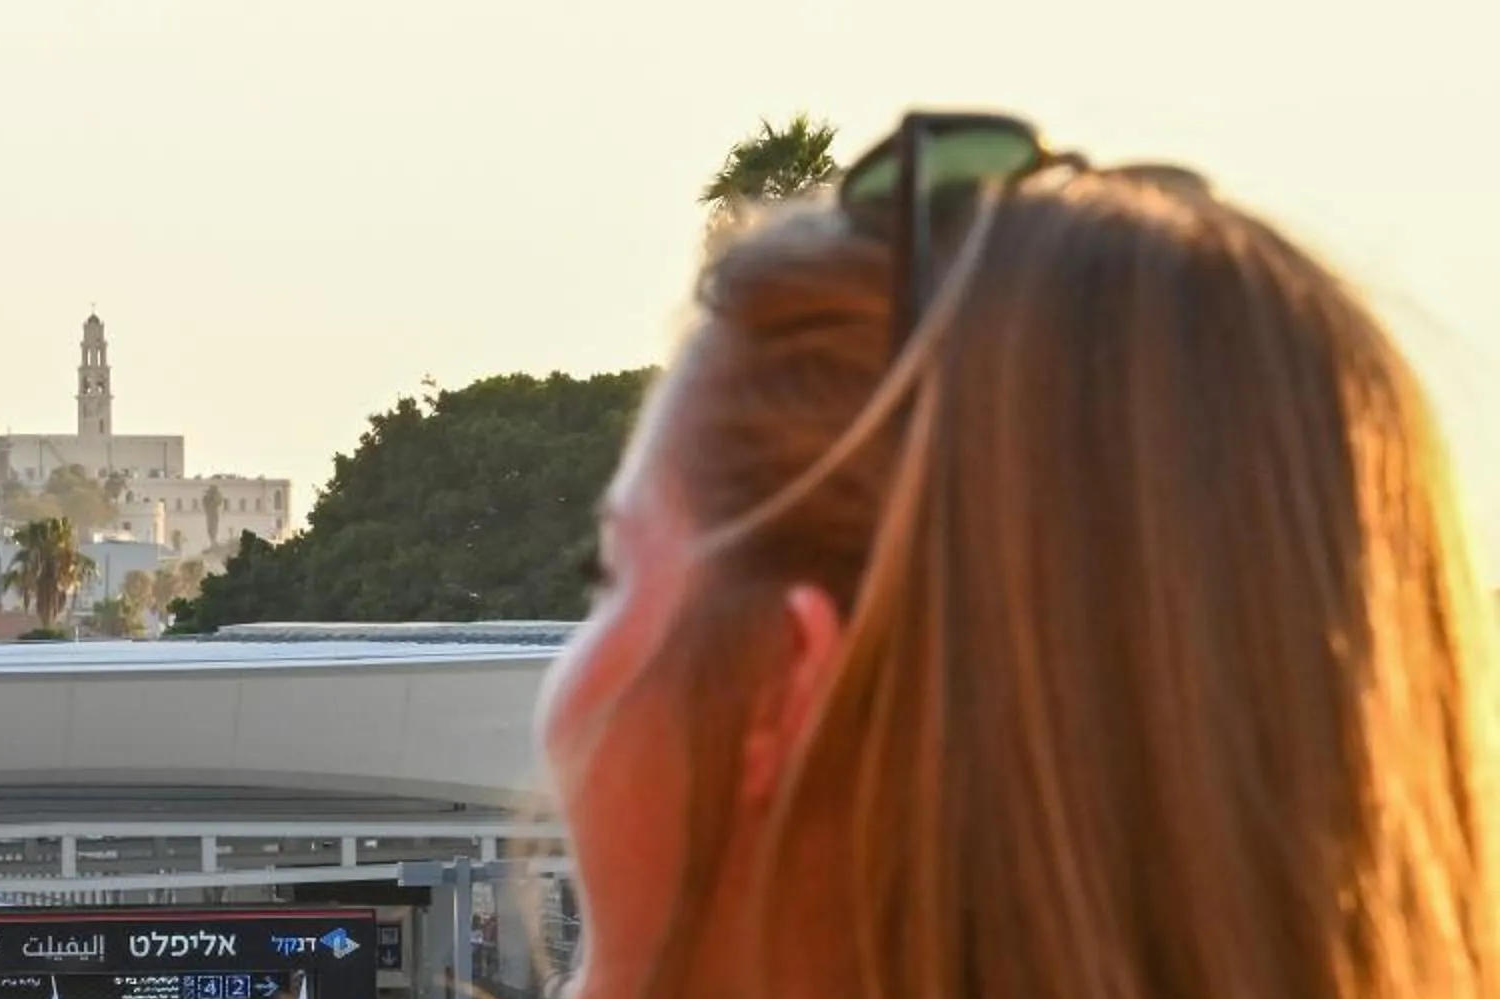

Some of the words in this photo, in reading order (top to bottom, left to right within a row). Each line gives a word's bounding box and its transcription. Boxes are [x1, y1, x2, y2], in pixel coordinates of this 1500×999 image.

[129, 930, 236, 958] אליפלט
[203, 980, 217, 995] 4
[232, 979, 245, 995] 2
